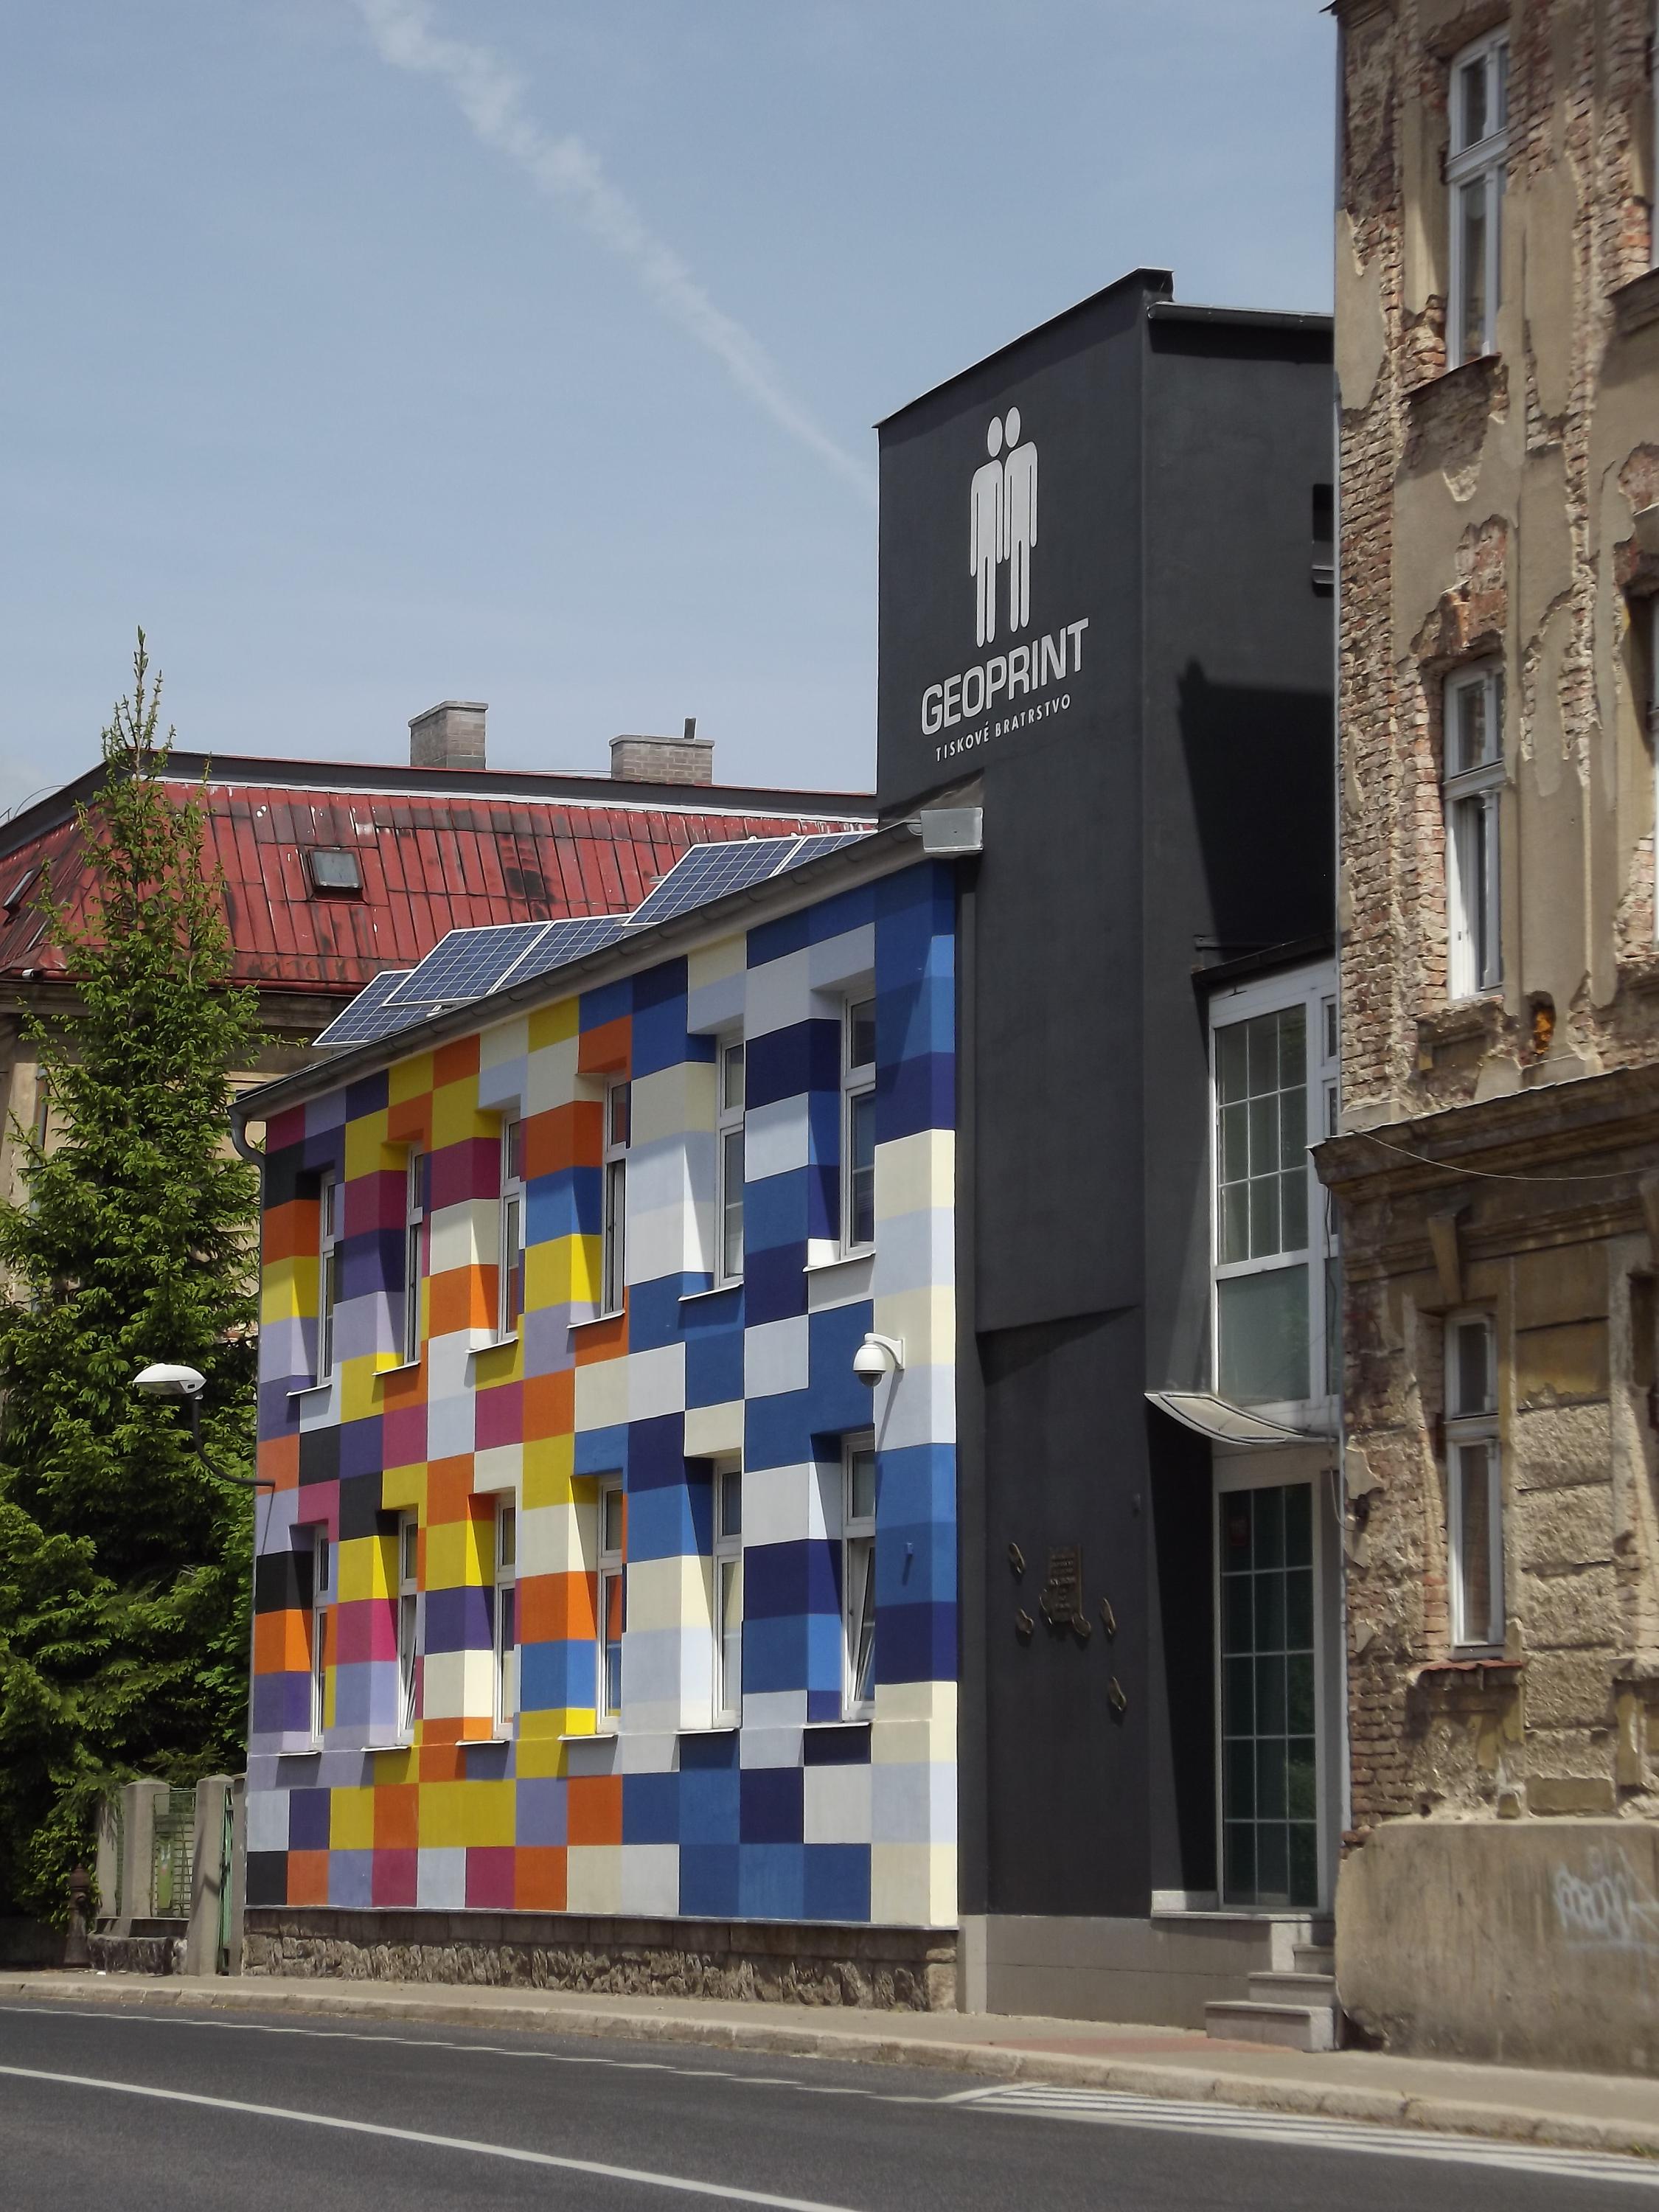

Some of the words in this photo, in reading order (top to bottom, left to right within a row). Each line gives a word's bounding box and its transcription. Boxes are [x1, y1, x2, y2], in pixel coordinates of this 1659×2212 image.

[922, 618, 1089, 735] GEOPRINT
[936, 721, 990, 762] TISKOVÉ
[995, 694, 1071, 737] BRATRSTVO
